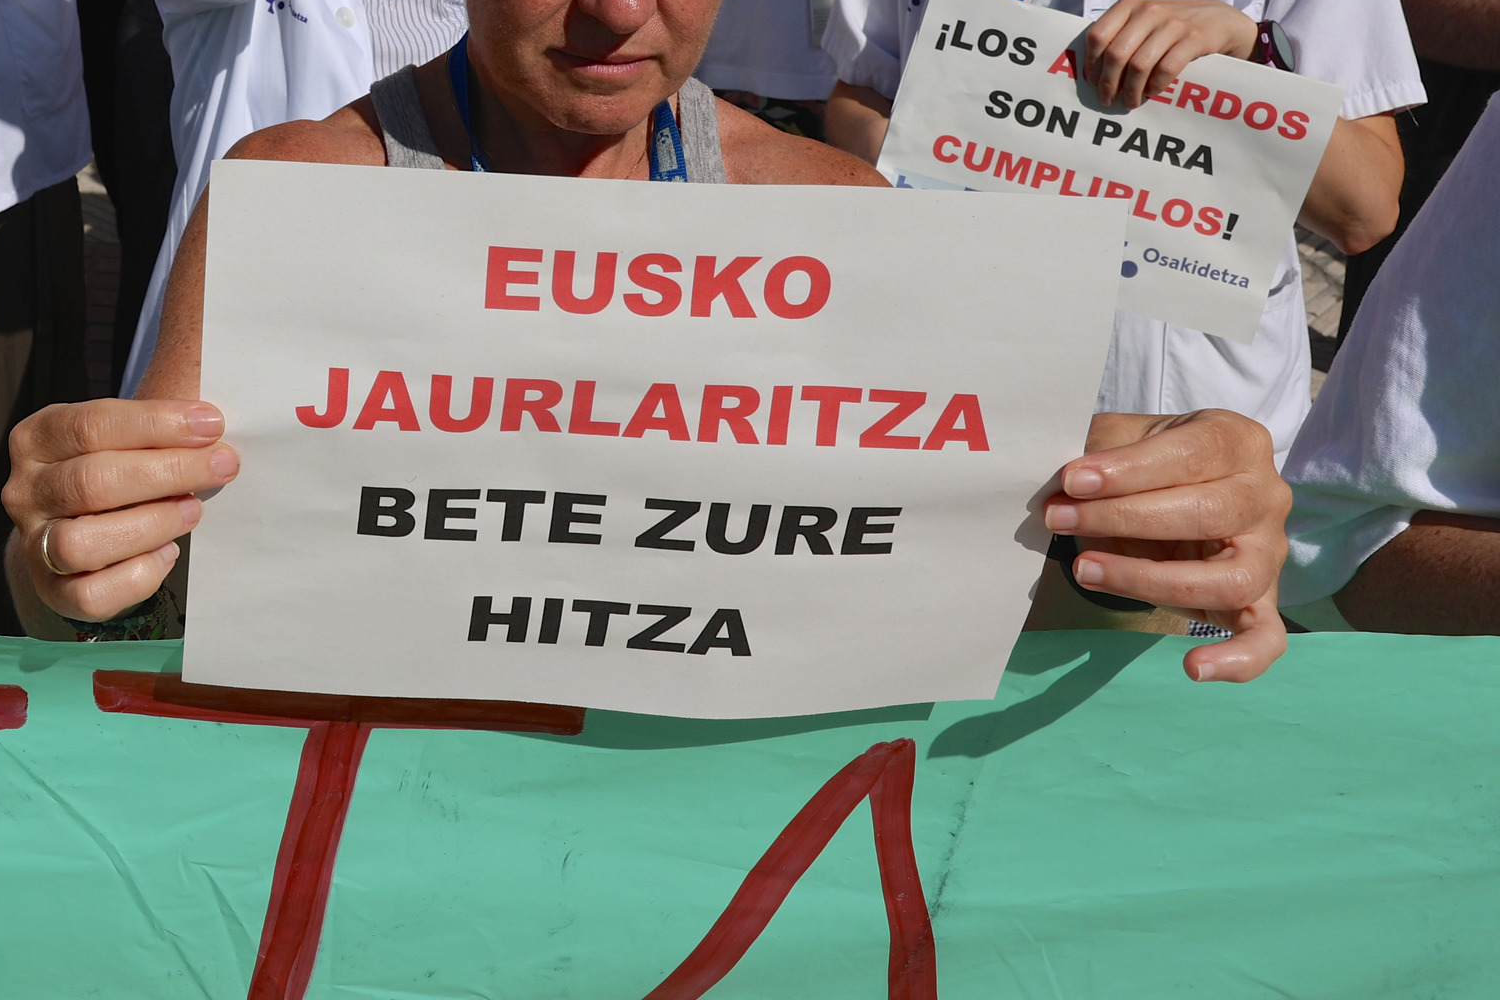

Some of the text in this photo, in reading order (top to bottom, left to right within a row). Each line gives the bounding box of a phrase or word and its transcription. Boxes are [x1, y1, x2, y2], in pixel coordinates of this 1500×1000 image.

[936, 20, 1310, 141] ¡LOS AERDOS
[984, 91, 1214, 176] SON PARA
[932, 134, 1240, 241] CUMPLIRLOS!
[484, 246, 832, 320] EUSKO
[1142, 248, 1250, 288] Osakidetza
[296, 368, 990, 452] JAURLARITZA
[356, 486, 902, 556] BETE ZURE
[468, 596, 752, 656] HITZA
